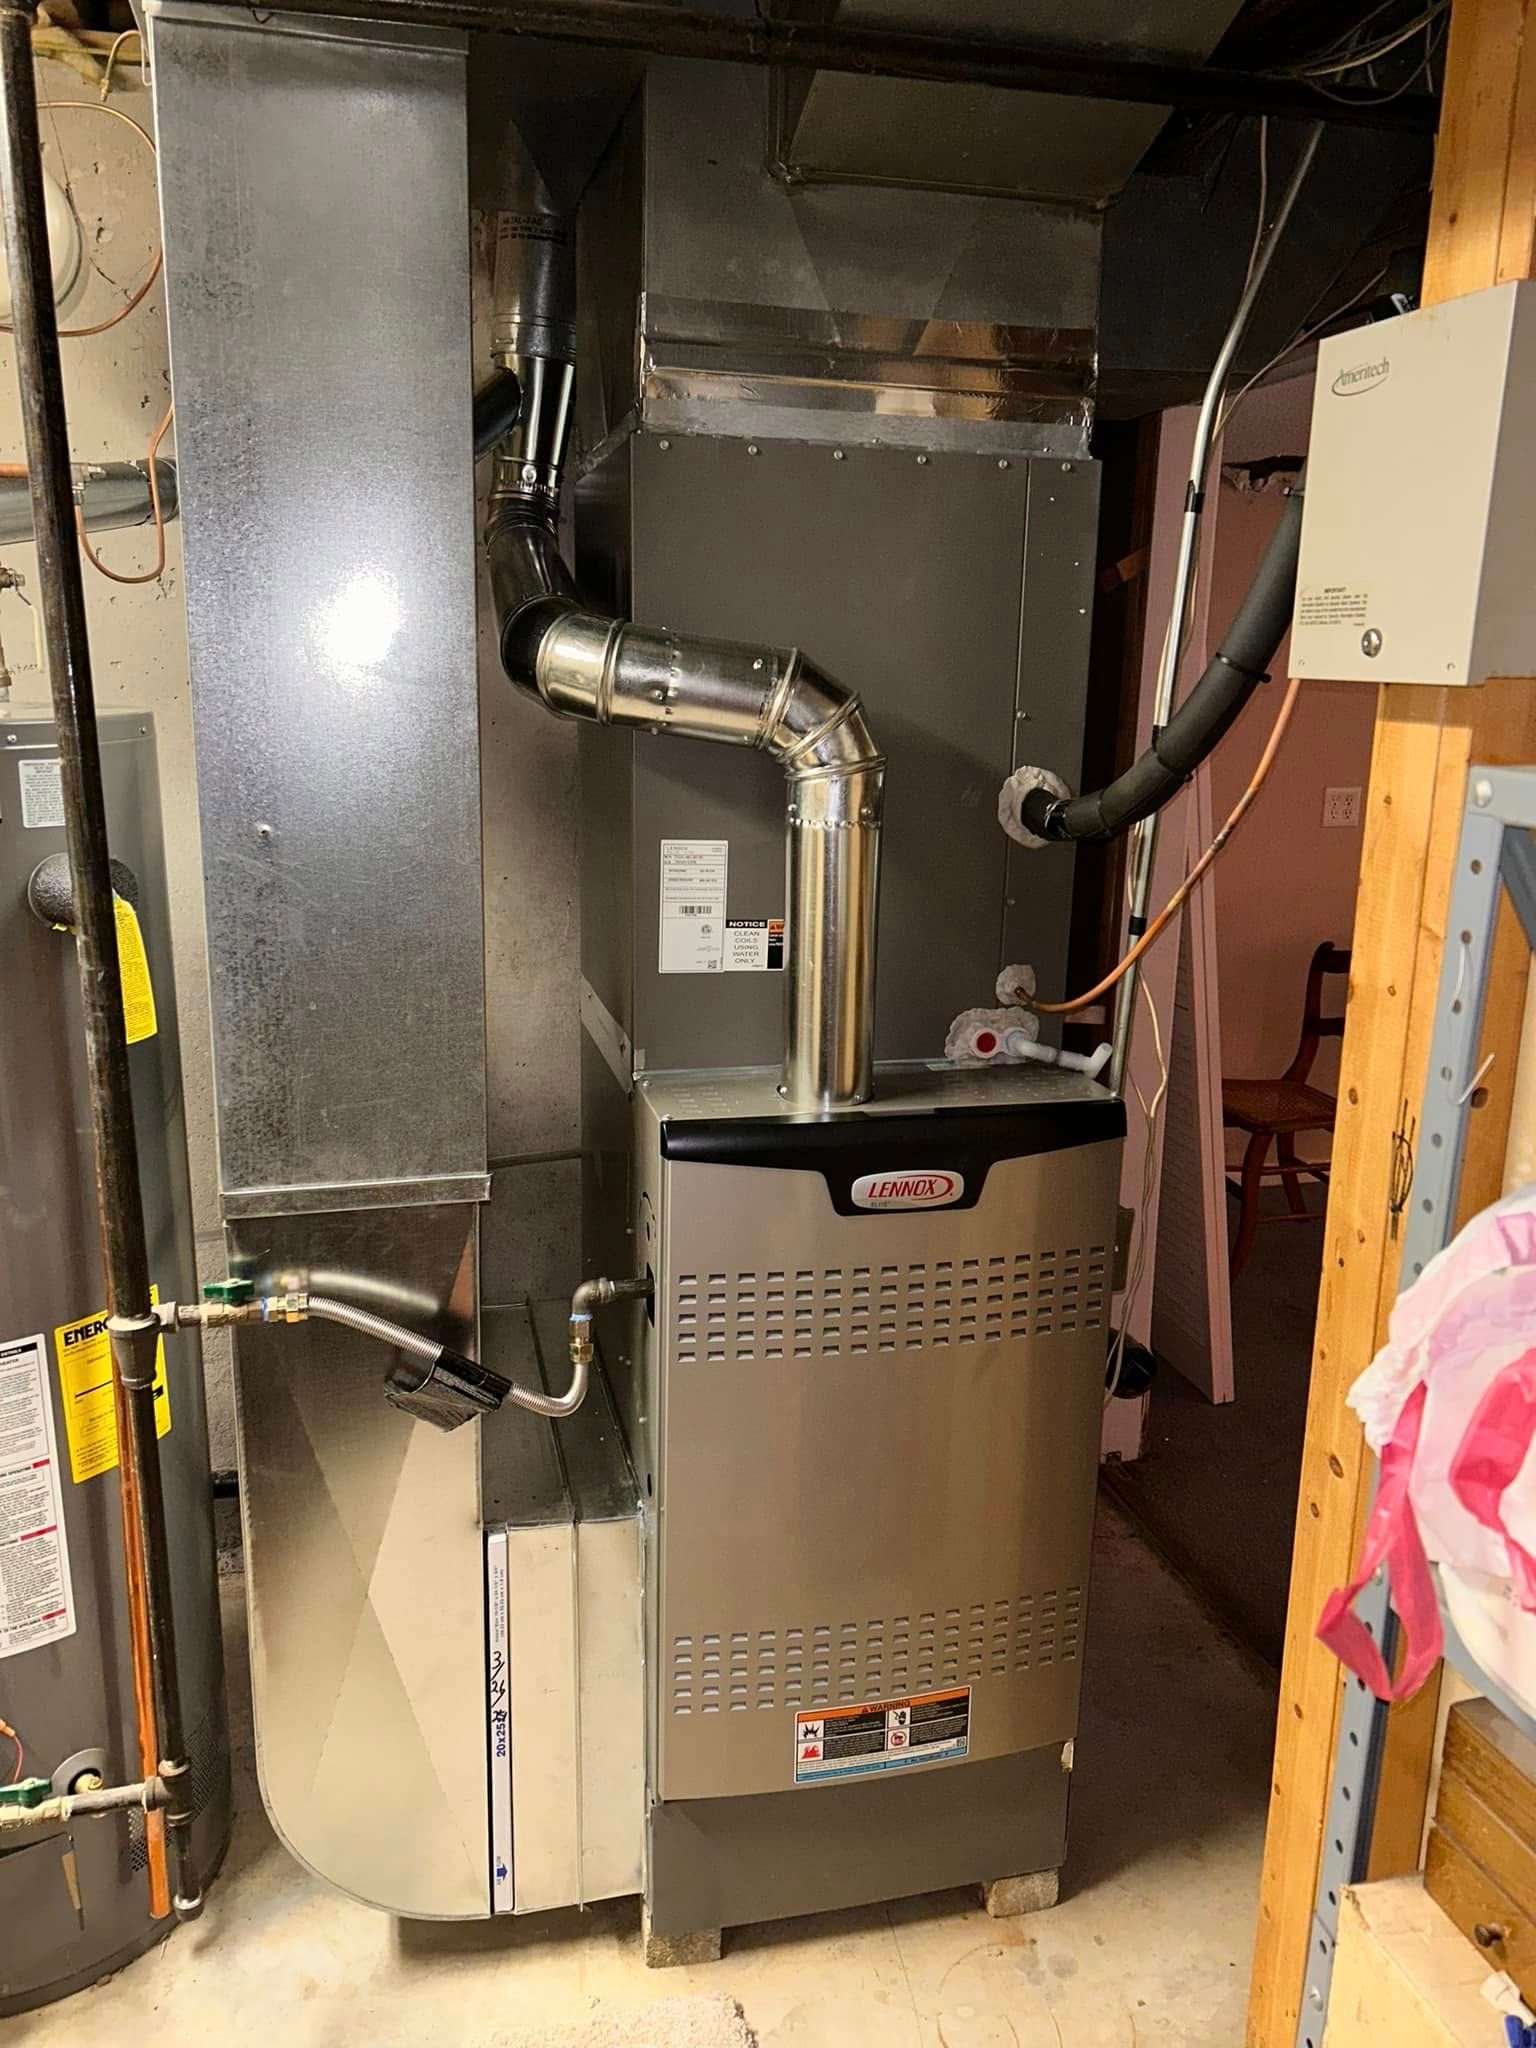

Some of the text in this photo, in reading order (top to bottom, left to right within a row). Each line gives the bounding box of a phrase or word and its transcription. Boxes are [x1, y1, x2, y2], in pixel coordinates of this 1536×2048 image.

[1337, 356, 1390, 387] Ameritech
[868, 1180, 938, 1199] LENNOX
[870, 1700, 911, 1713] WARNING
